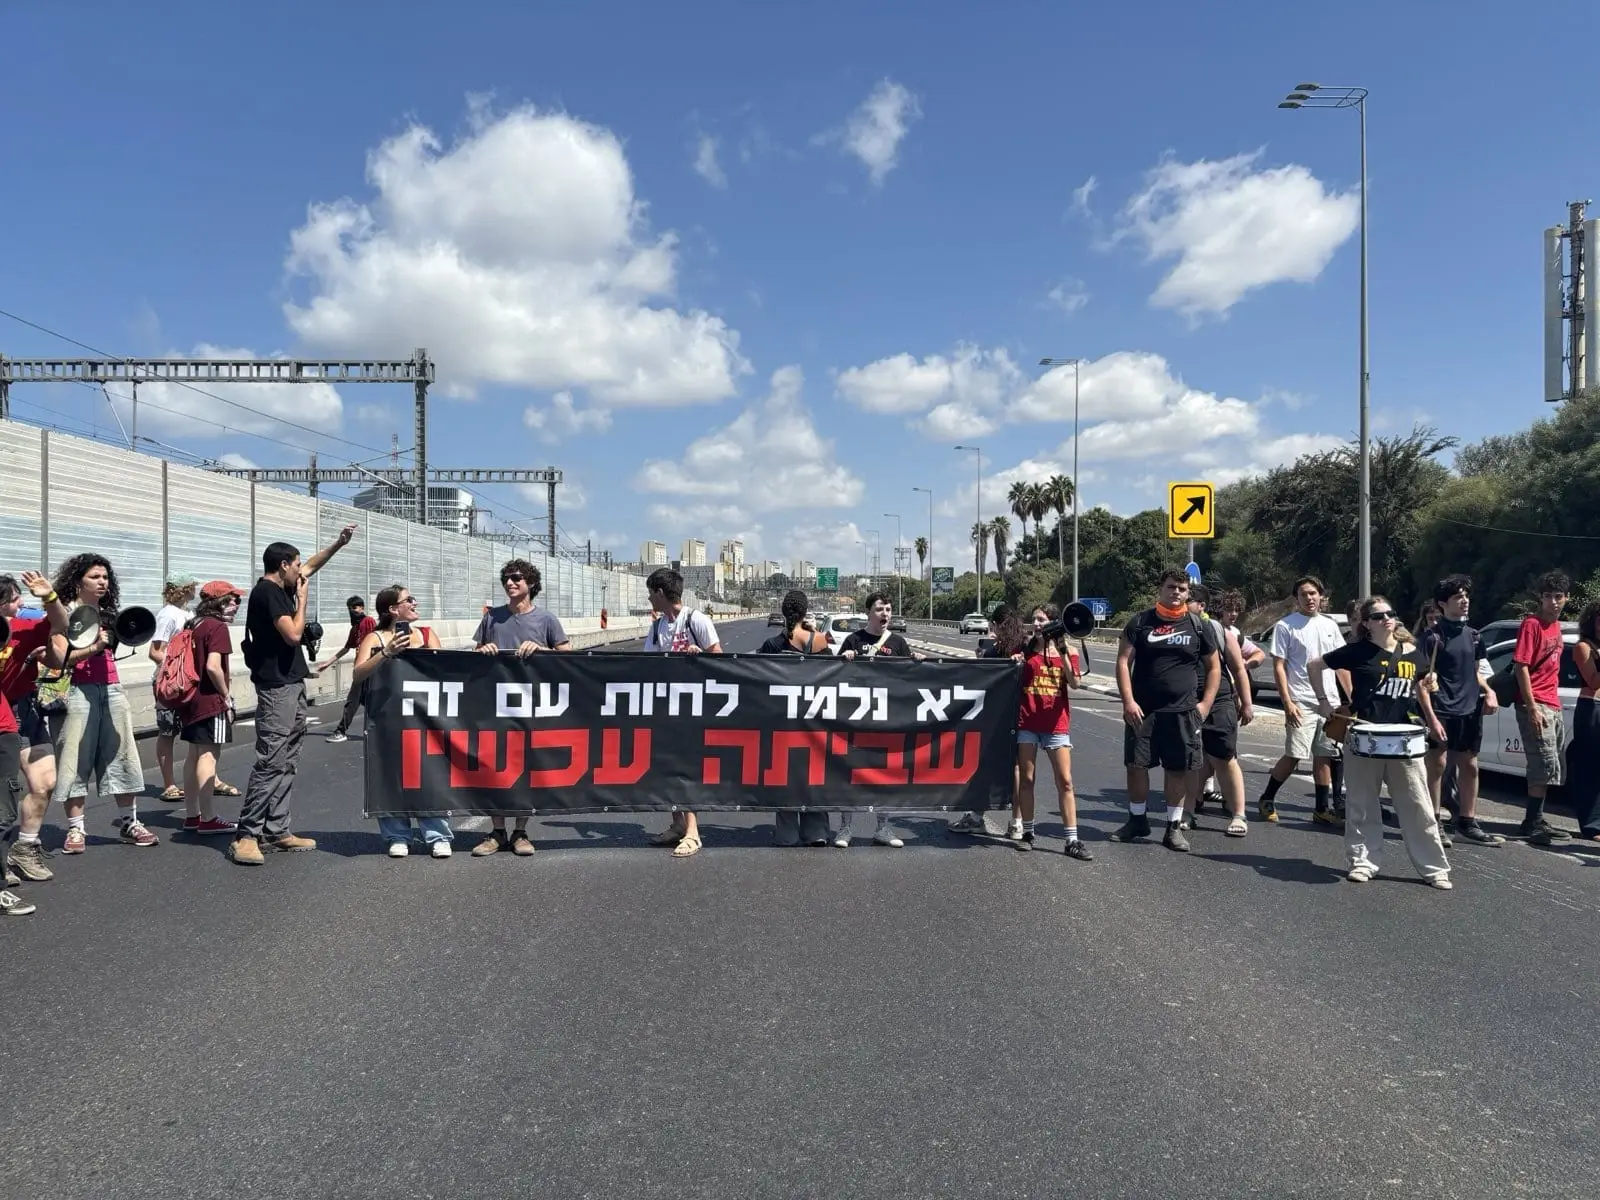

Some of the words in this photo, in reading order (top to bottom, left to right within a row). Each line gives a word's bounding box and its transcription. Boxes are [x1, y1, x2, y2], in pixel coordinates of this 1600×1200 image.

[402, 680, 464, 717] זה
[495, 682, 570, 717] עם
[600, 679, 739, 716] לחיות
[769, 682, 888, 720] נלמד
[916, 685, 986, 721] לא
[402, 728, 652, 789] עכשיו
[703, 730, 981, 785] שביתה
